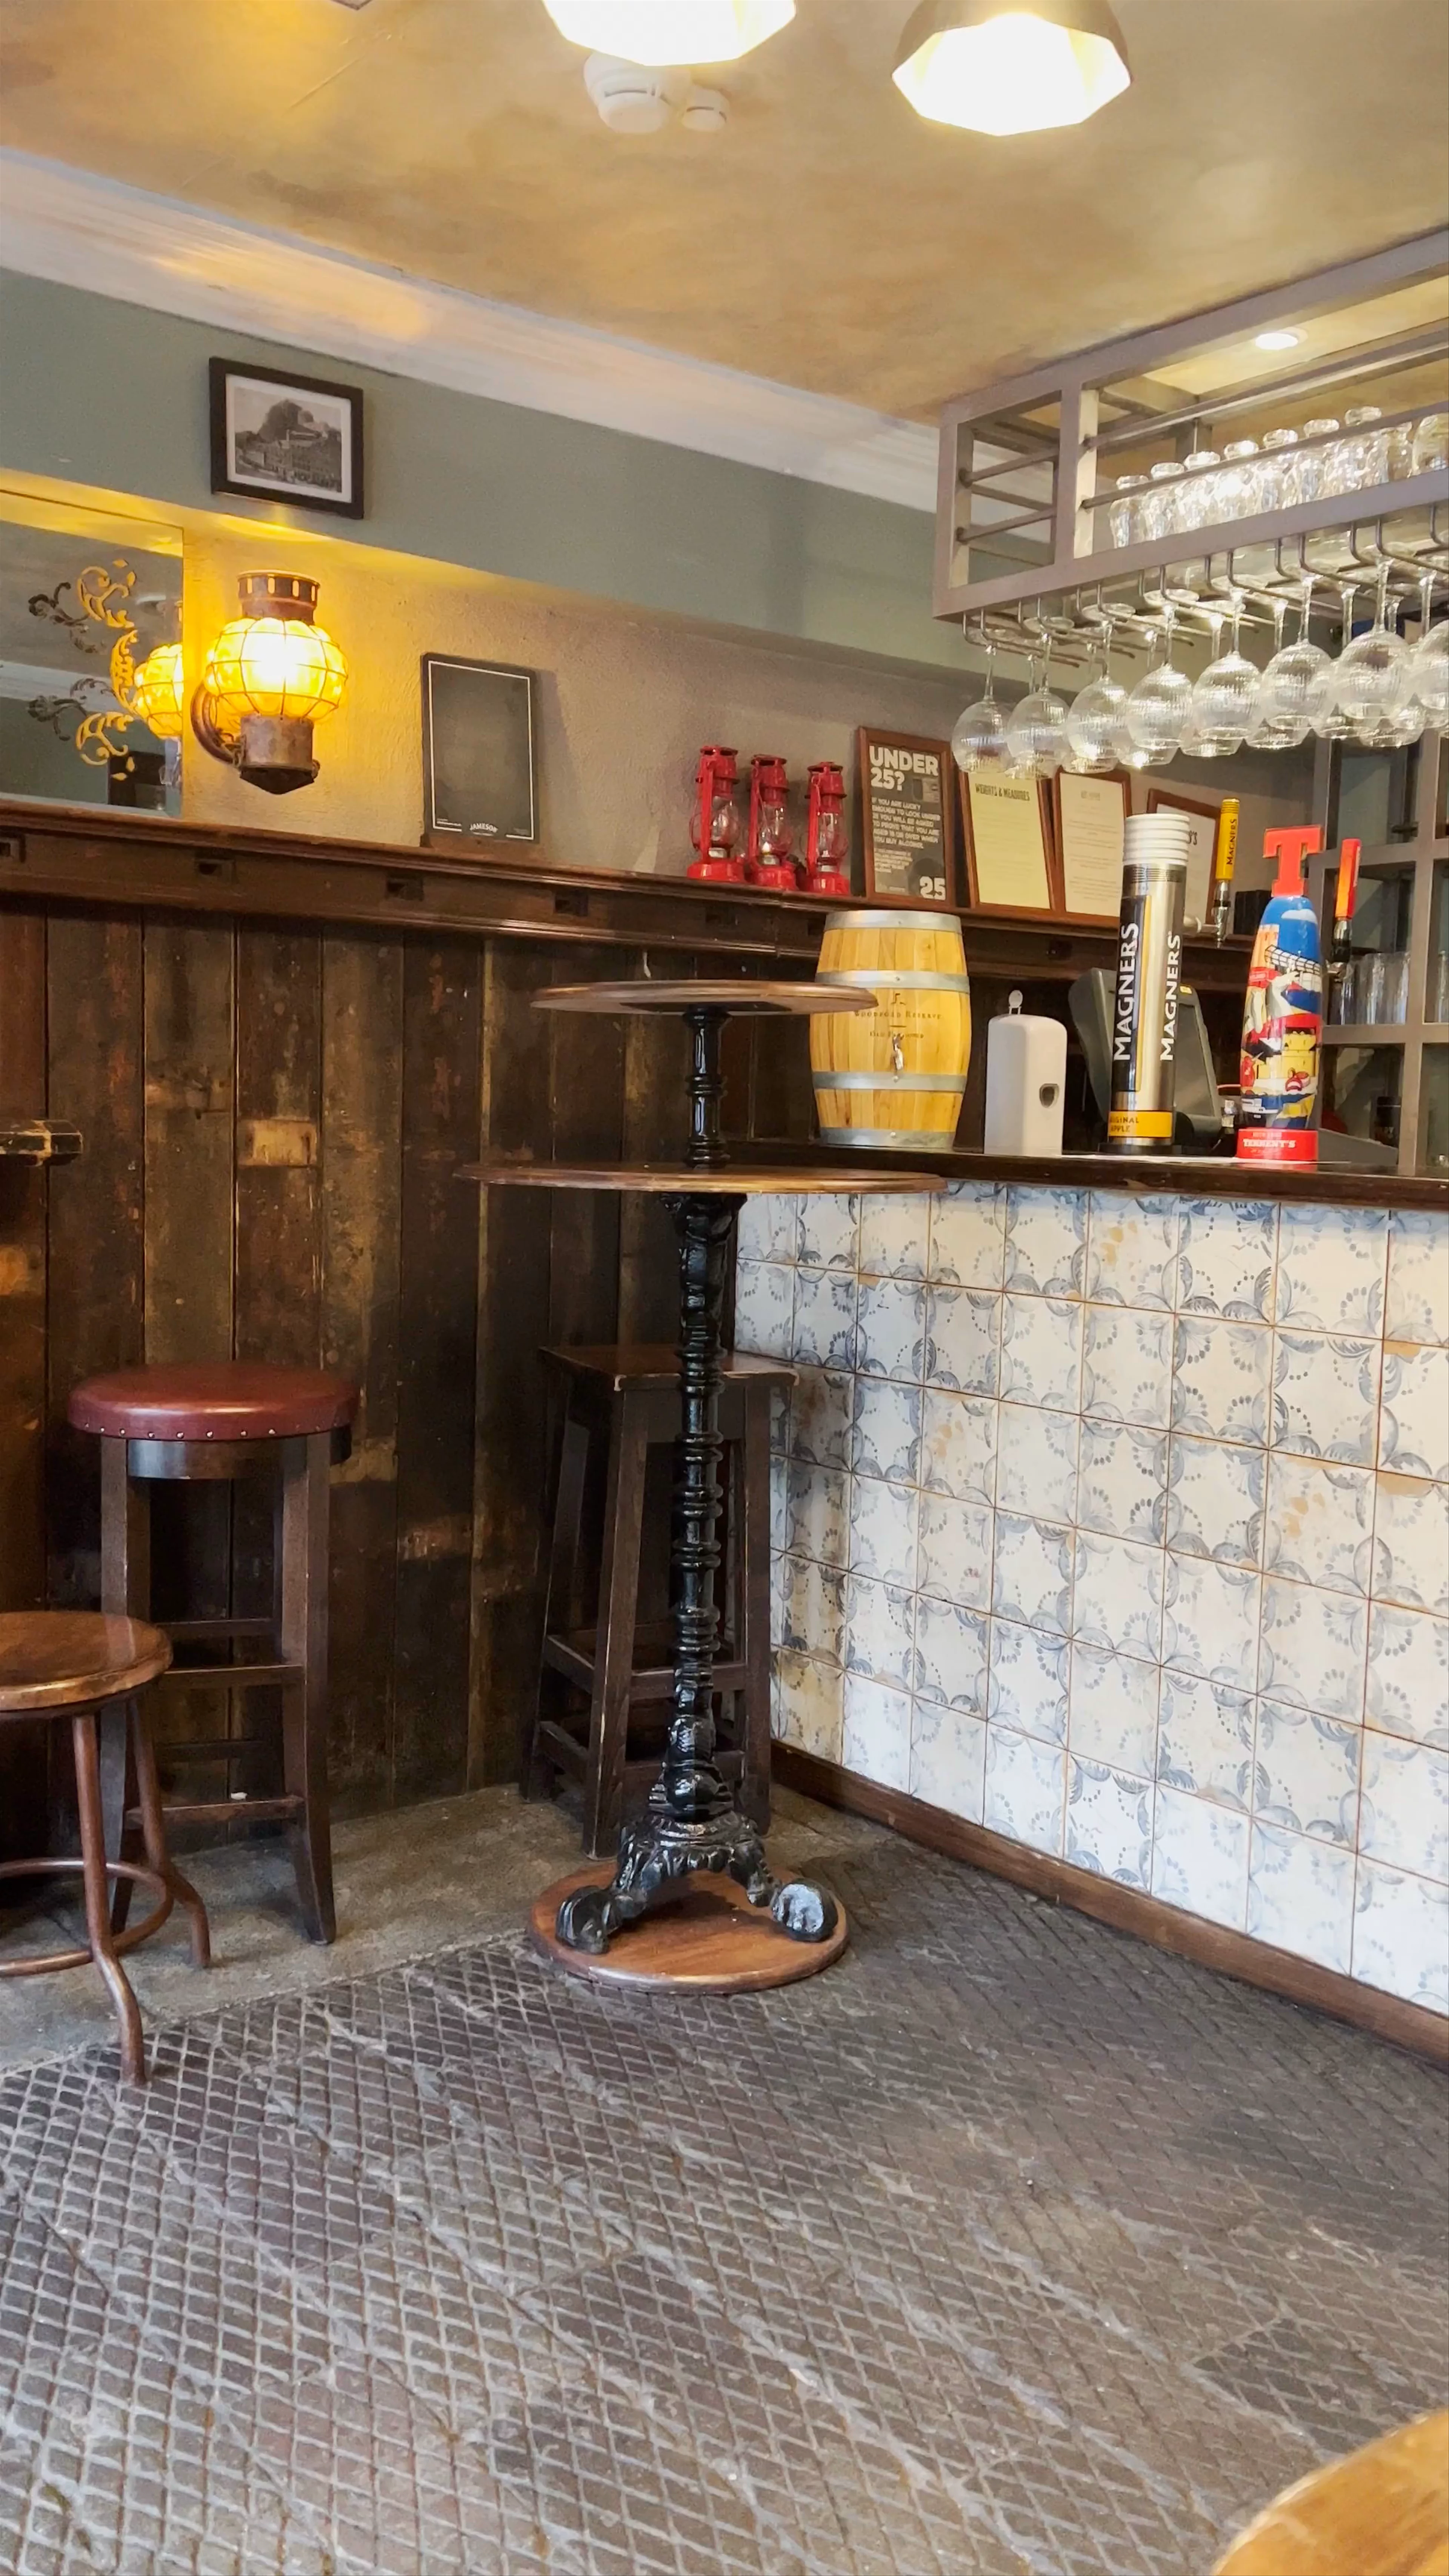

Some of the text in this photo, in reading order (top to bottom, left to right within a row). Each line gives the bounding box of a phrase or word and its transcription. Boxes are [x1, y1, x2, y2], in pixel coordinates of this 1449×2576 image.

[869, 746, 939, 777] UNDER
[871, 767, 905, 791] 25?
[1003, 787, 1030, 801] MEASURES
[470, 823, 498, 833] JAMESON
[1226, 818, 1237, 864] MAGNERS
[1262, 824, 1325, 897] T
[919, 875, 946, 901] 25
[1114, 923, 1139, 1061] MAGNERS
[1160, 935, 1180, 1061] MAGNERS
[906, 1010, 943, 1020] RESERVE
